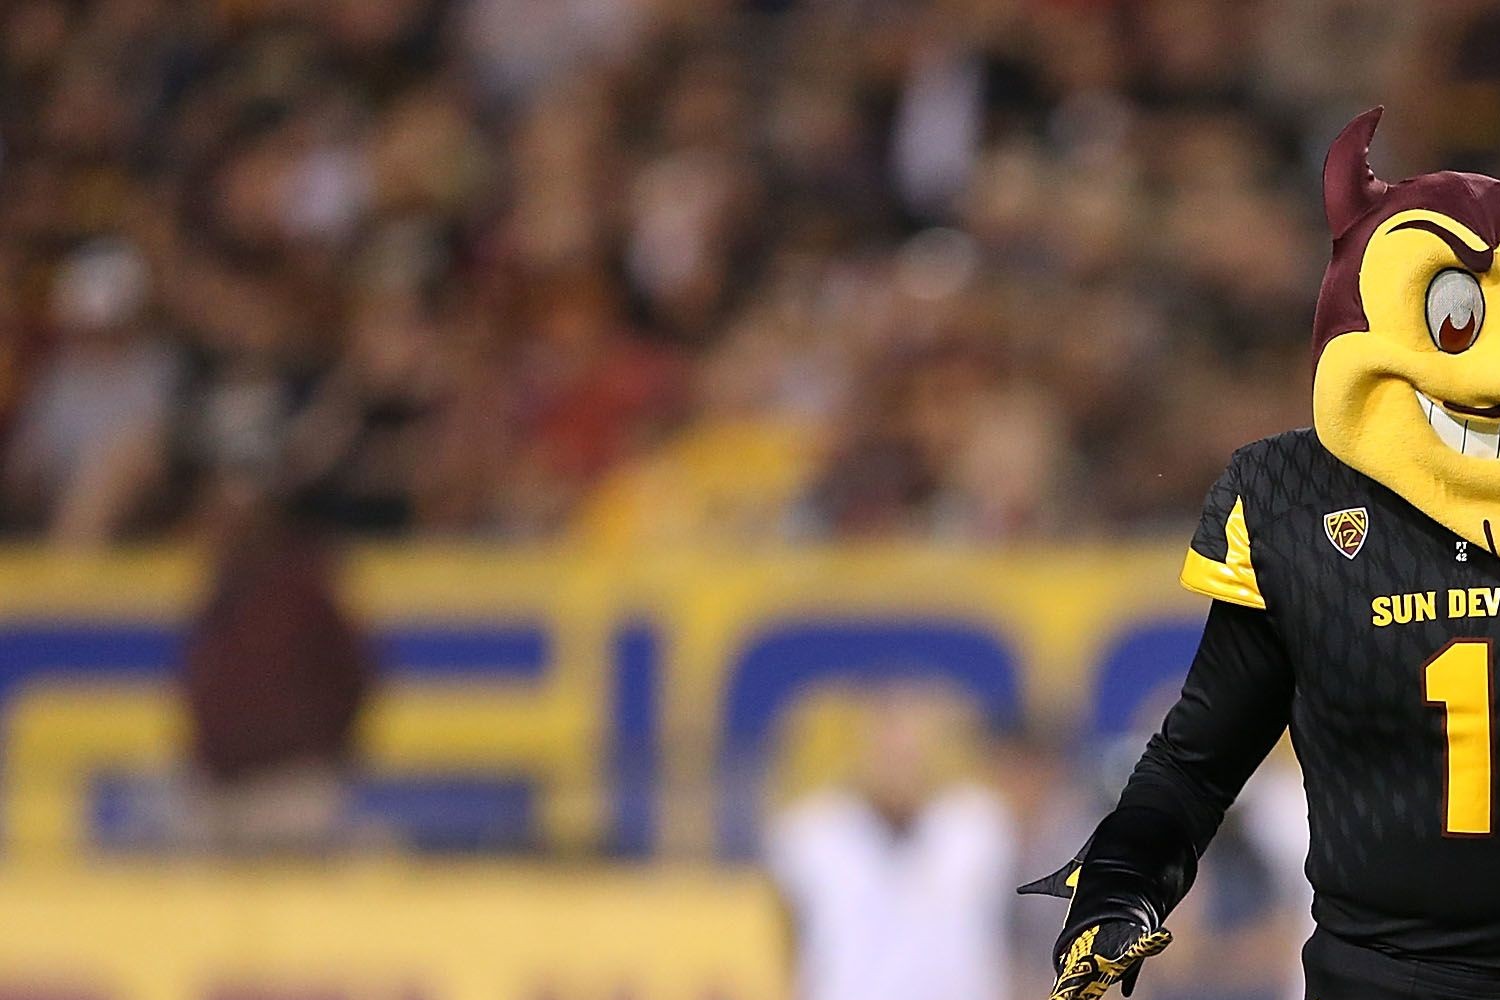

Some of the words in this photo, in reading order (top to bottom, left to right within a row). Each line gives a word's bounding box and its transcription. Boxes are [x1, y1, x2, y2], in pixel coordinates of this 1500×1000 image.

[1327, 511, 1366, 538] PAC
[1338, 528, 1360, 549] 12
[1455, 553, 1468, 562] 42
[1371, 591, 1437, 627] SUN
[1420, 637, 1493, 838] 1
